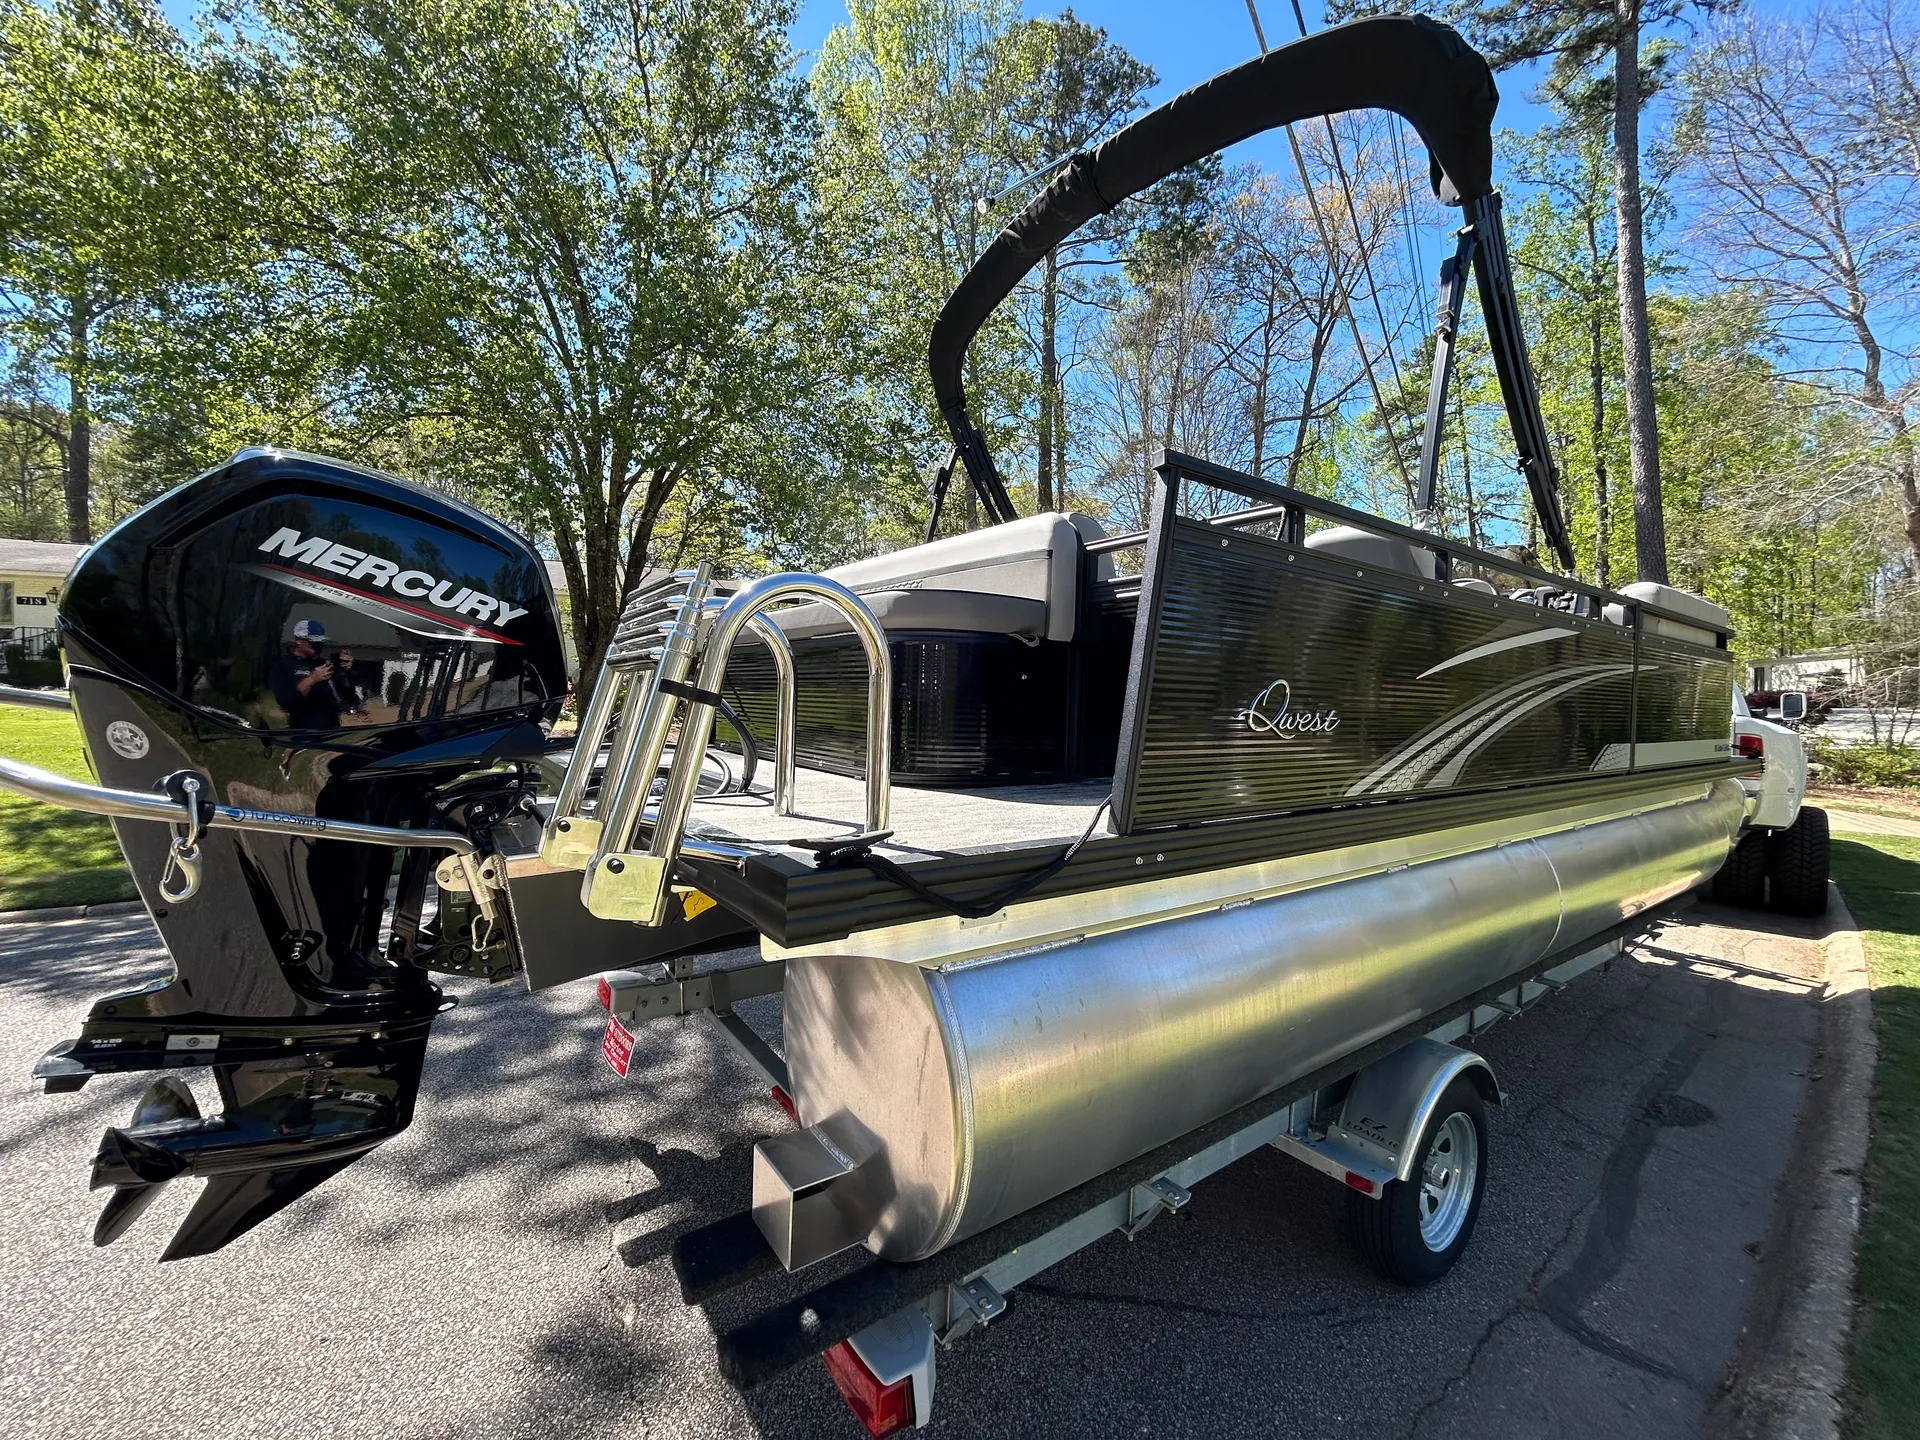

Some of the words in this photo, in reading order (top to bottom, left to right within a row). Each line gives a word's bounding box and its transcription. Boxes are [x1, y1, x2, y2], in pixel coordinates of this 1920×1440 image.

[258, 526, 529, 628] MERCURY
[291, 577, 390, 611] FOURSTROKE
[1235, 678, 1341, 740] Qwest
[1346, 1121, 1399, 1149] LOADER
[1360, 1116, 1388, 1133] EZ
